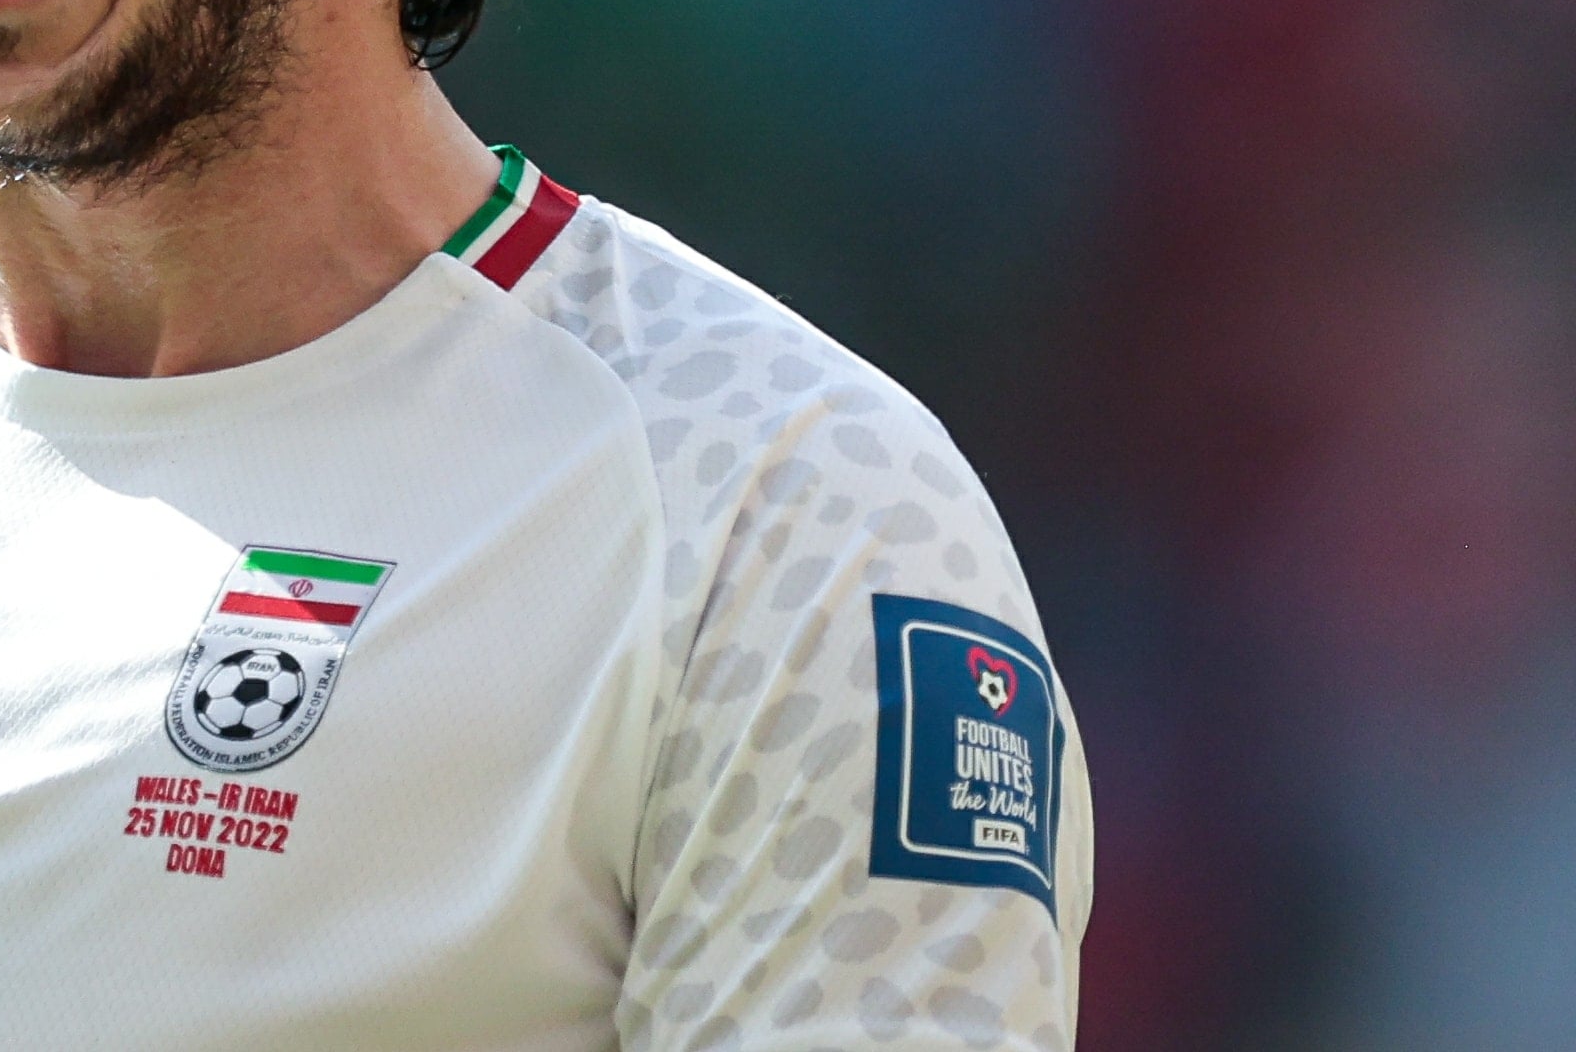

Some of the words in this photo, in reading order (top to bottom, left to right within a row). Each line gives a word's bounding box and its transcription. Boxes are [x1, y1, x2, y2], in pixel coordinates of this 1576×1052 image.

[171, 703, 214, 761] FEDERATION
[213, 750, 266, 765] ISLAMIC
[268, 709, 317, 755] REPUBLIC
[310, 691, 324, 707] OF
[318, 659, 337, 690] IRAN
[956, 717, 1032, 765] FOOTBALL
[956, 744, 1033, 798] UNITES
[135, 776, 202, 806] WALES
[244, 786, 298, 821] IRAN
[950, 780, 986, 810] the
[988, 785, 1036, 832] World
[124, 807, 157, 837] 25
[160, 810, 215, 841] NOV
[217, 816, 289, 853] 2022
[982, 827, 1020, 845] FIFA
[166, 844, 226, 878] DOHA
